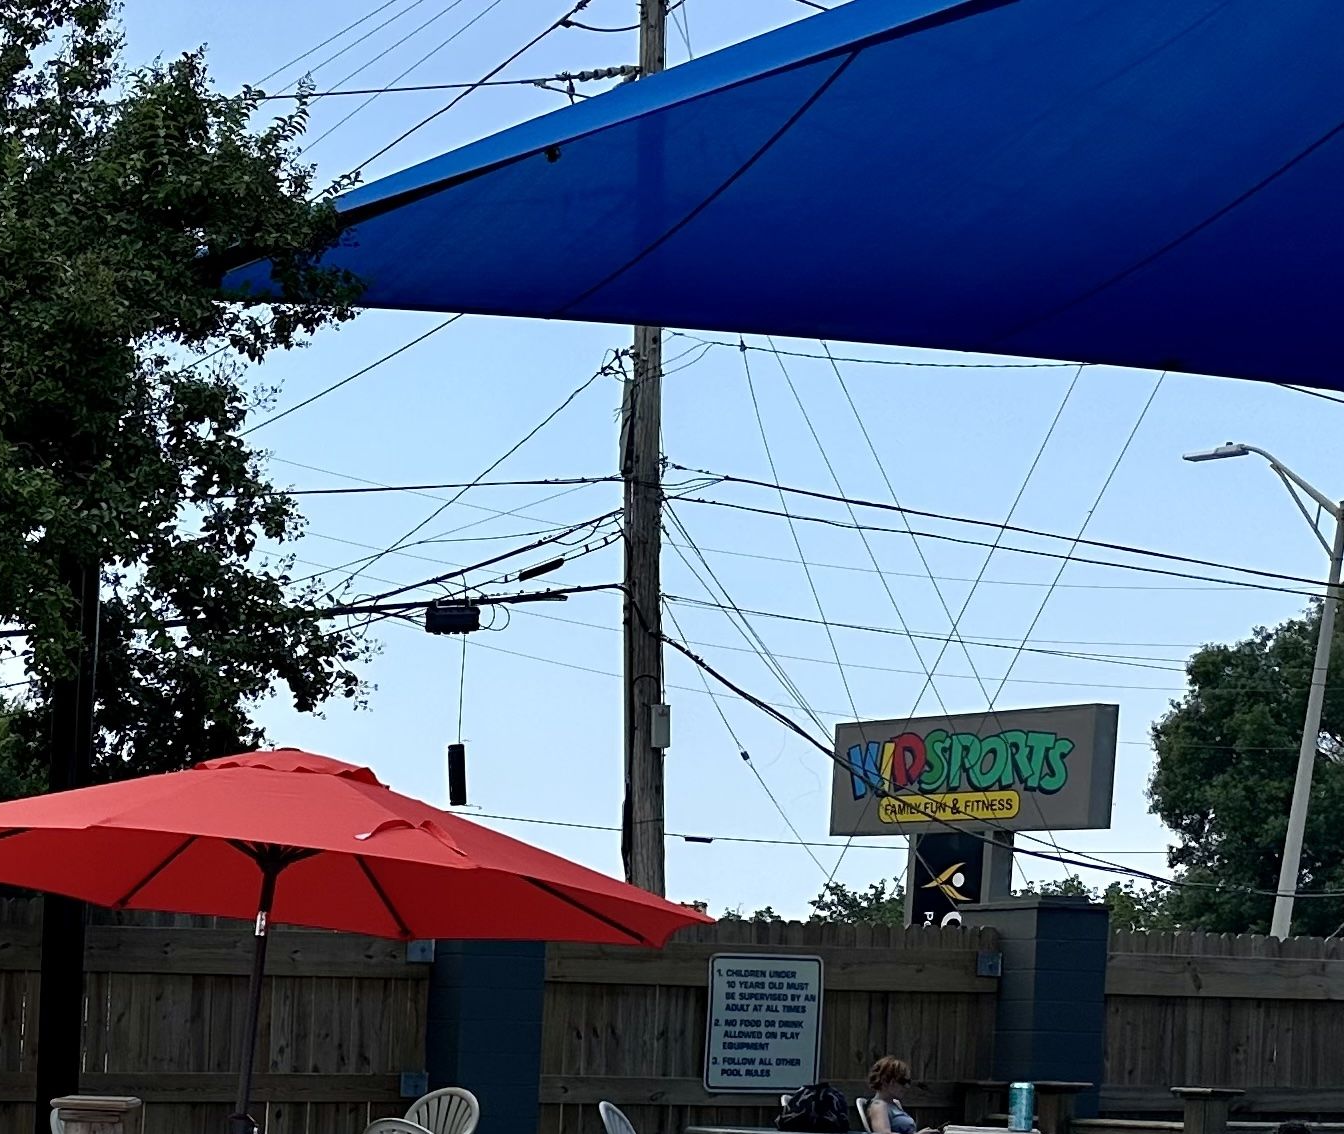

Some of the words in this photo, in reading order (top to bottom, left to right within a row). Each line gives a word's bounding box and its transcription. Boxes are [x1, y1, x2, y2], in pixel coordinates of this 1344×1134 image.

[847, 727, 1075, 801] KIDSPORTS
[884, 801, 922, 816] FAMILY
[923, 801, 947, 815] FUN
[951, 798, 961, 815] &
[964, 798, 1013, 813] FITNESS
[725, 969, 767, 978] CHILDREN
[768, 970, 797, 979] UNDER
[726, 980, 736, 989] 10
[738, 981, 766, 990] YEARS
[768, 981, 785, 990] OLD
[786, 982, 810, 991] MUST
[725, 992, 736, 1001] BE
[738, 992, 789, 1002] SUPERVISED
[790, 993, 802, 1002] BY
[803, 994, 817, 1002] AN
[724, 1003, 750, 1012] ADULT
[752, 1004, 763, 1012] AT
[765, 1004, 780, 1013] ALL
[782, 1005, 807, 1014] TIMES
[724, 1019, 737, 1027] NO
[739, 1019, 762, 1028] FOOD
[764, 1019, 776, 1028] OR
[778, 1020, 804, 1029] DRINK
[723, 1030, 763, 1039] ALLOWED
[765, 1031, 778, 1039] ON
[779, 1031, 800, 1040] PLAY
[722, 1041, 770, 1051] EQUIPMENT
[722, 1057, 756, 1066] FOLLOW
[758, 1057, 773, 1066] ALL
[775, 1058, 801, 1067] OTHER
[720, 1068, 742, 1077] POOL
[744, 1068, 771, 1077] RULES
